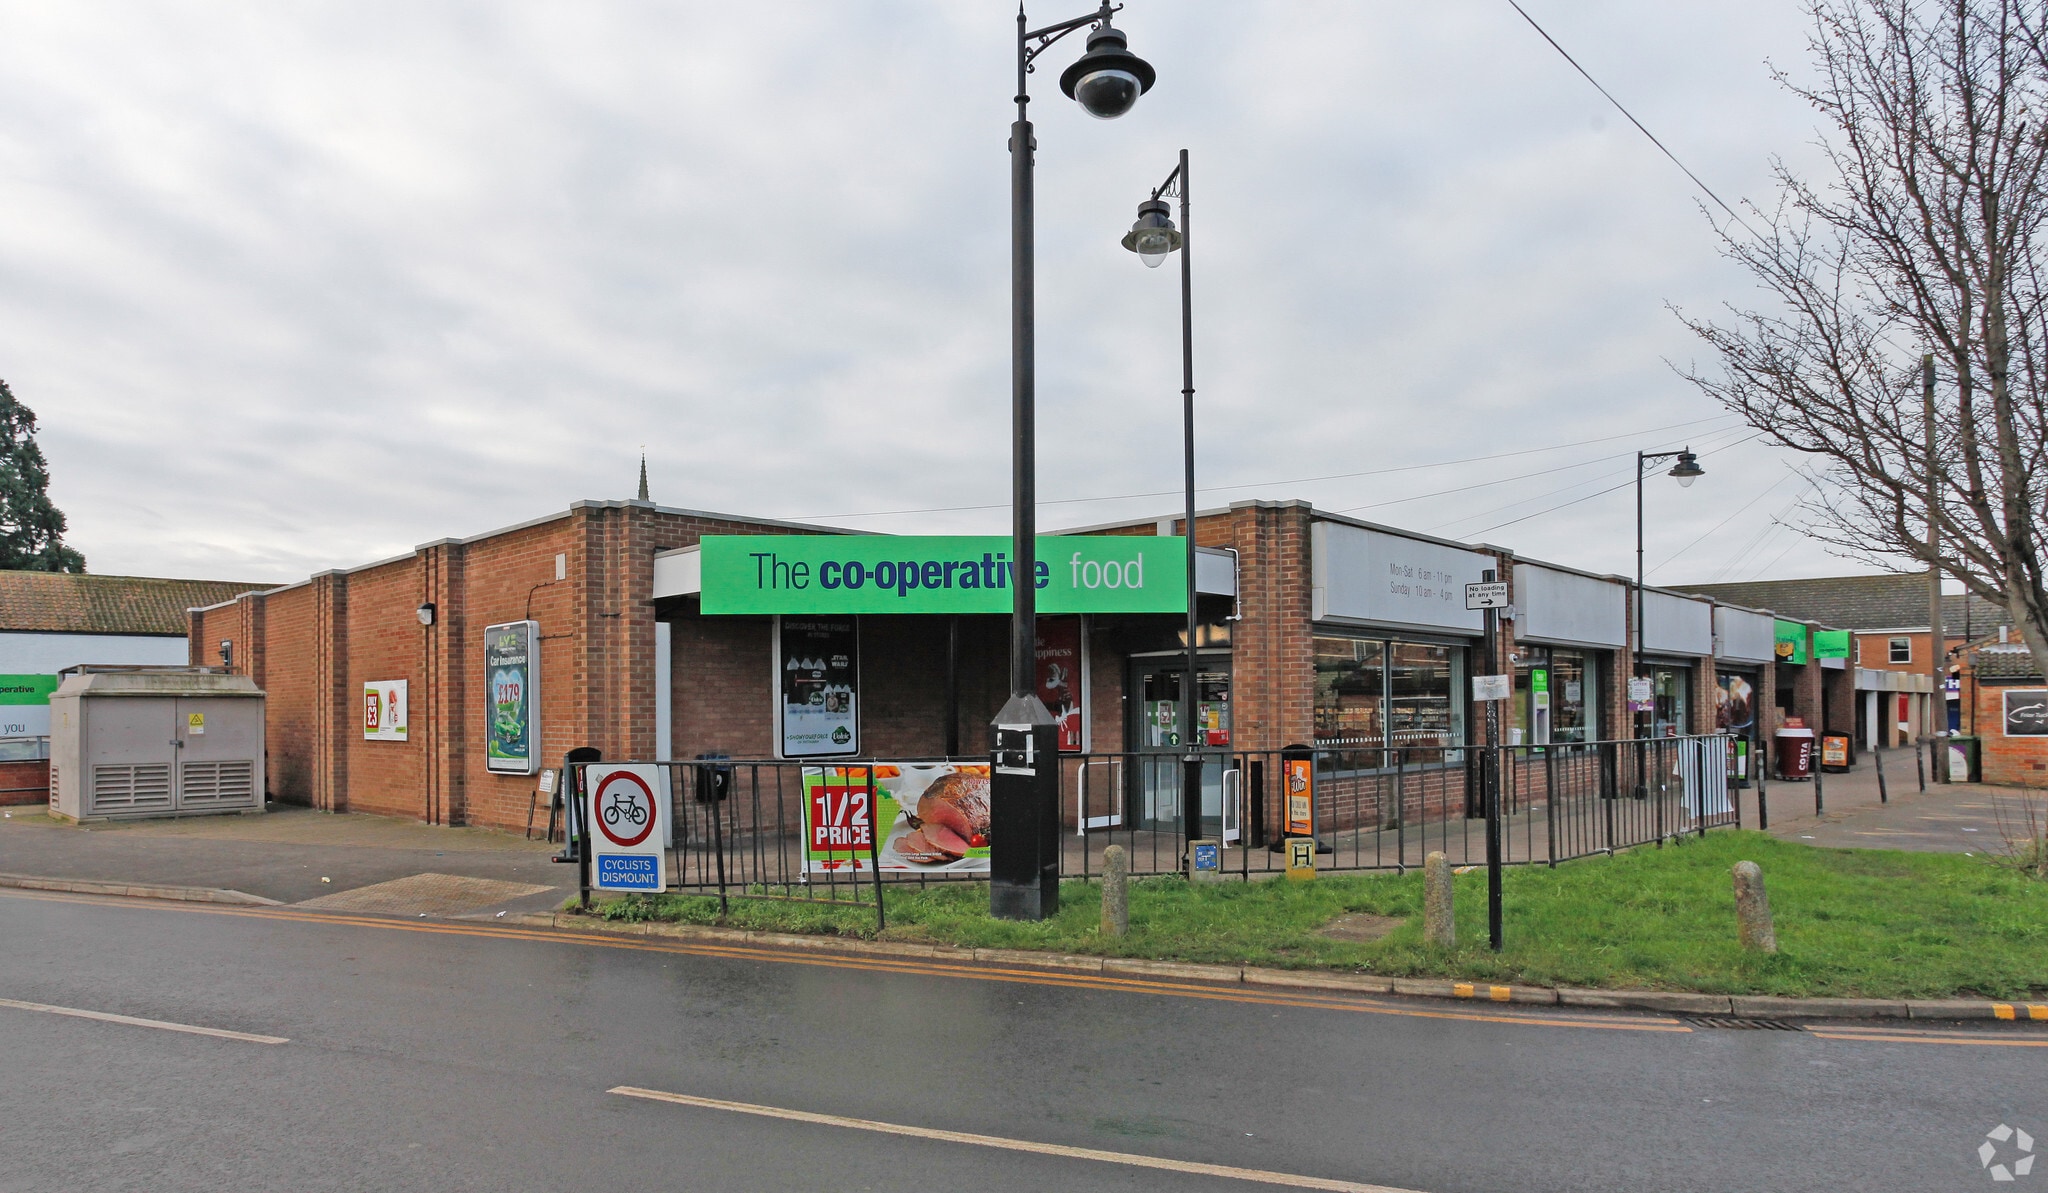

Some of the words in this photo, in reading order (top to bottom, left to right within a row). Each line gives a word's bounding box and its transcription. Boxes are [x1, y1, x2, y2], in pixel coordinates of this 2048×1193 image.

[749, 553, 809, 589] The
[1069, 551, 1143, 588] food
[1390, 563, 1413, 578] Mon-Sat
[1418, 568, 1422, 580] 6
[1424, 571, 1431, 580] am
[1437, 571, 1442, 582] 11
[1444, 574, 1452, 585] pm
[1390, 581, 1410, 598] Sunday
[1416, 586, 1422, 597] 10
[1424, 588, 1432, 598] am
[1440, 589, 1444, 600] 4
[1444, 592, 1452, 601] pm
[1481, 585, 1505, 593] loading
[490, 656, 499, 667] Car
[500, 655, 526, 666] Insurance
[498, 683, 520, 705] £179
[4, 724, 25, 735] you
[1798, 742, 1809, 771] COSTA
[816, 793, 868, 826] 1/2
[816, 826, 871, 845] PRICE
[604, 860, 651, 871] CYCLISTS
[1294, 846, 1310, 866] H
[602, 872, 655, 884] DISMOUNT
